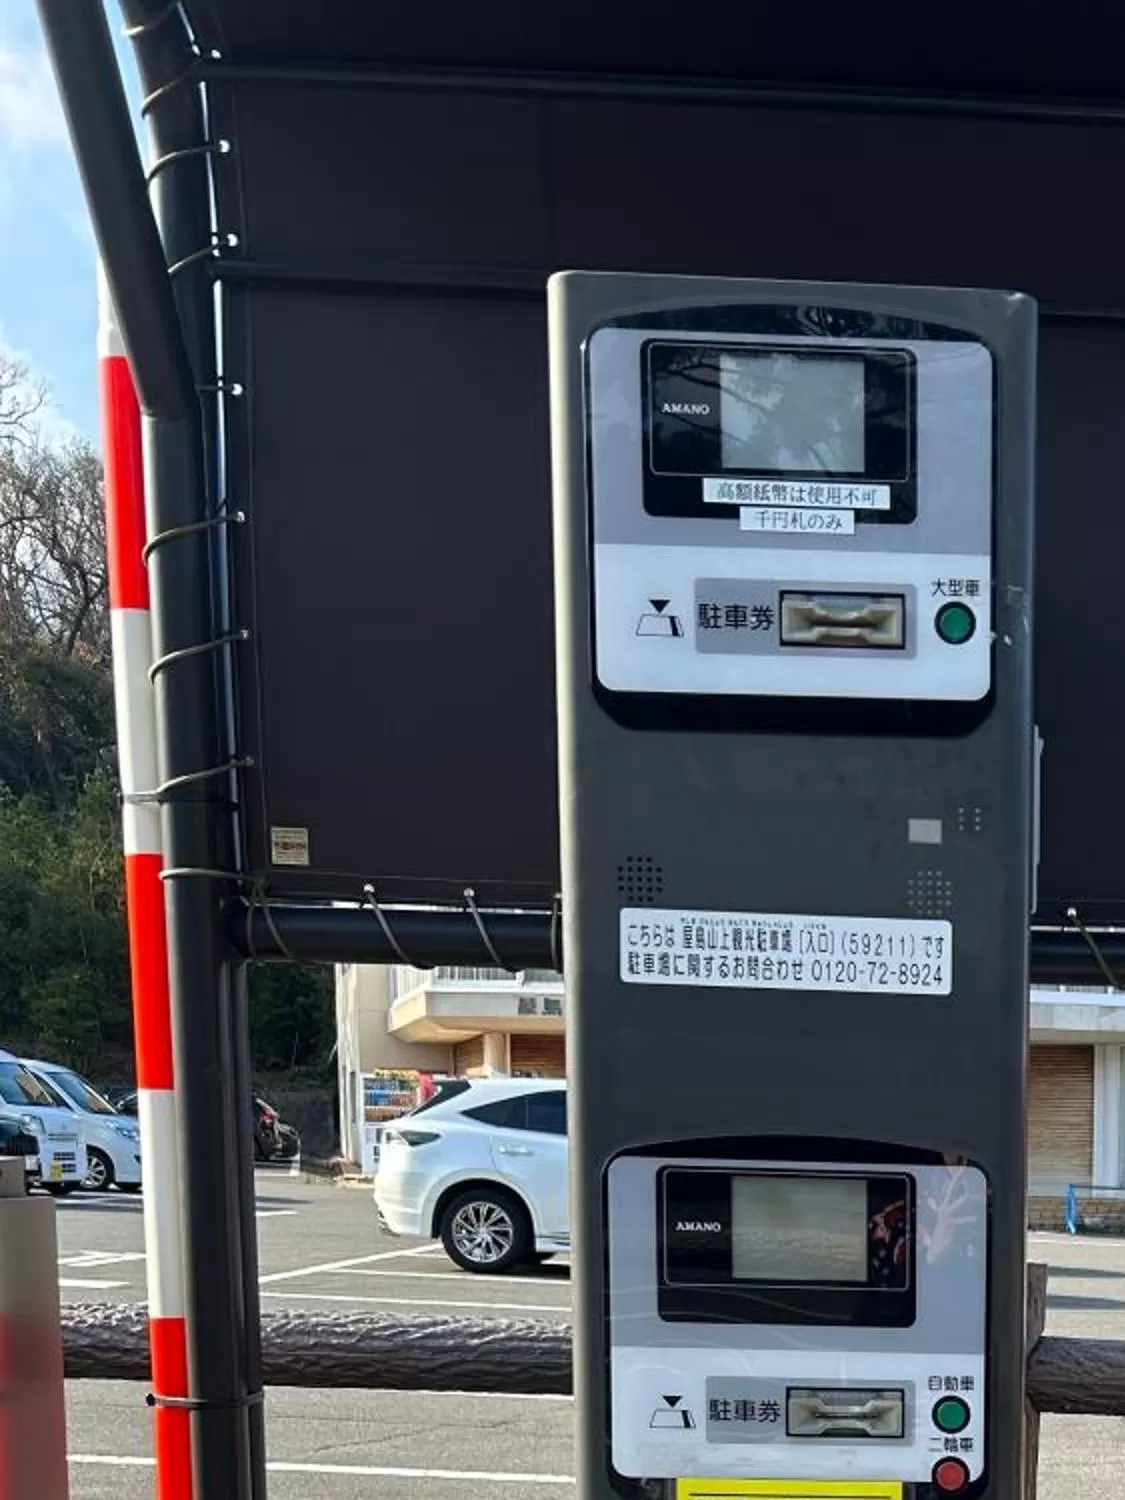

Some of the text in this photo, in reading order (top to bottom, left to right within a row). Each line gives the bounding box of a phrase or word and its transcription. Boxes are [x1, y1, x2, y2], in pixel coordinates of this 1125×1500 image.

[662, 402, 710, 416] AMANO
[717, 481, 877, 507] 高額紙幣は使用不可
[754, 510, 844, 530] 千円札のみ
[931, 577, 981, 598] 大型車
[698, 602, 775, 630] 駐車券
[811, 959, 943, 987] 0120-72-8924
[676, 1220, 721, 1233] AMANO
[928, 1375, 975, 1392] 自動車
[708, 1398, 782, 1424] 駐車券
[928, 1437, 974, 1453] 二輪車
